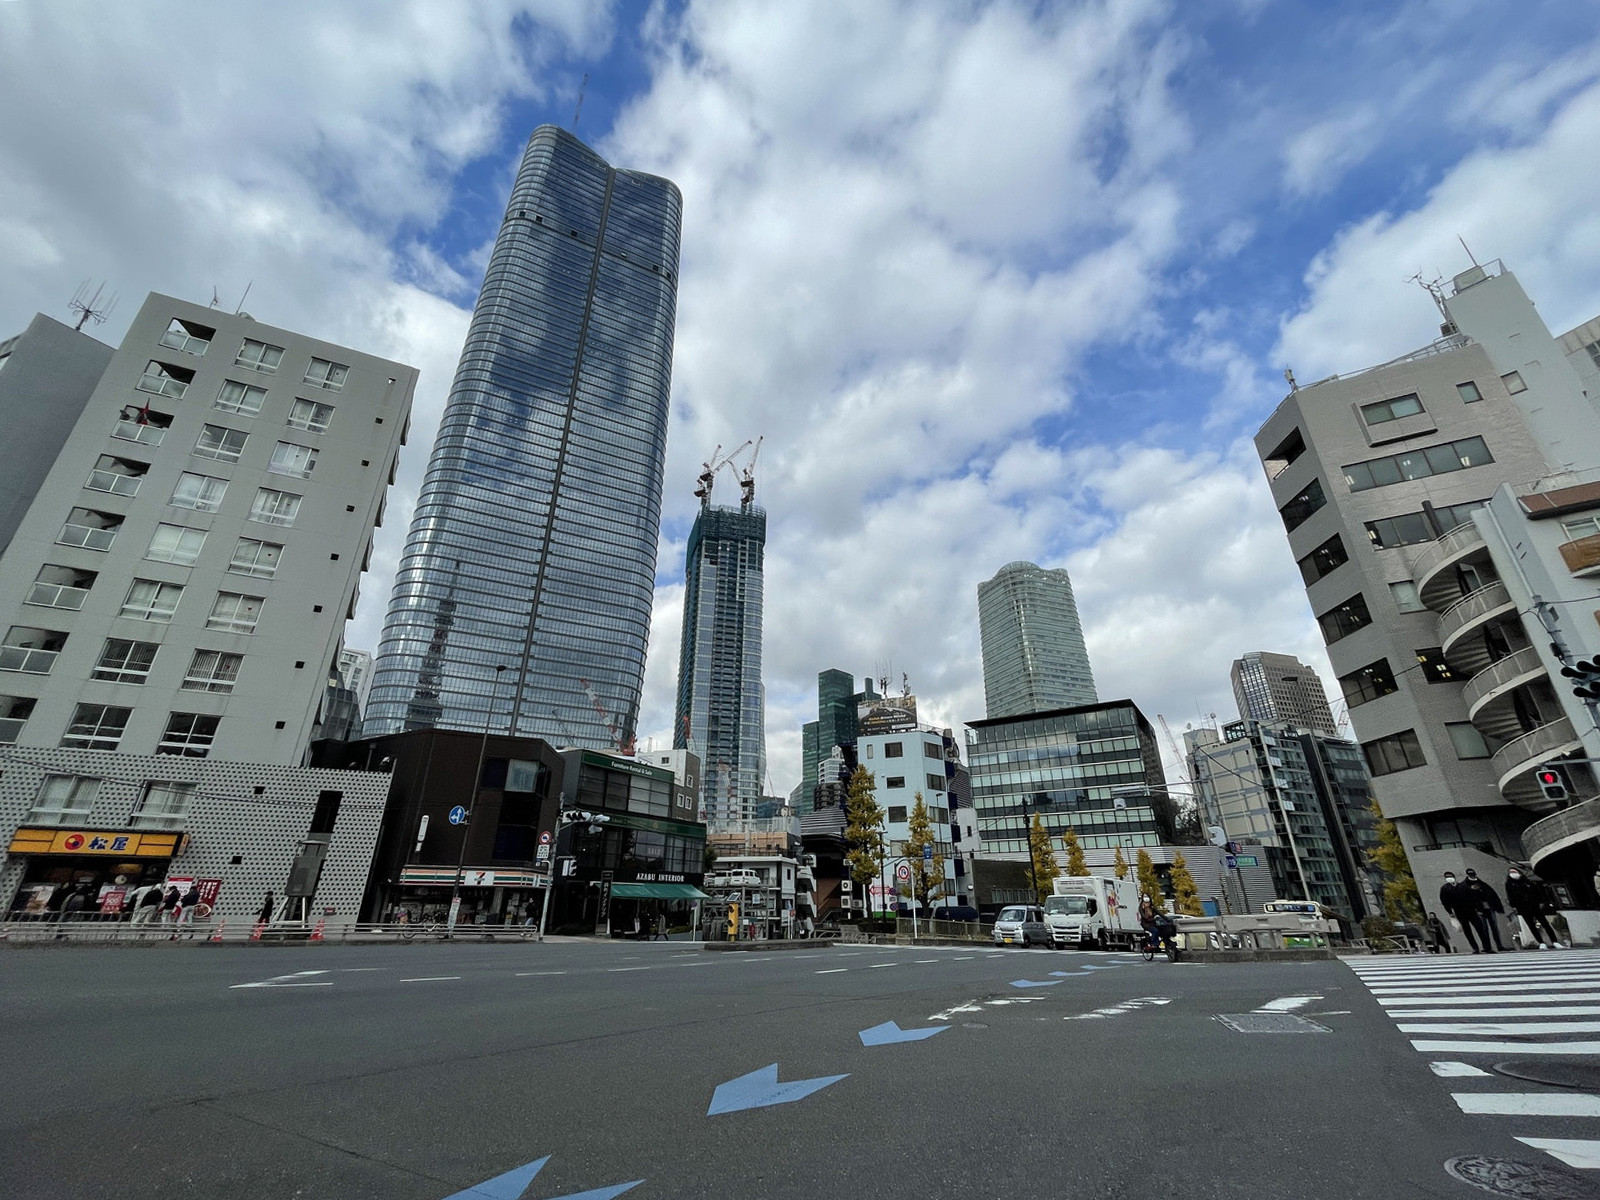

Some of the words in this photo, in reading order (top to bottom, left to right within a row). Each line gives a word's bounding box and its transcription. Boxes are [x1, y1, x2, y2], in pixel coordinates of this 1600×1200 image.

[88, 836, 129, 851] 松屋
[635, 872, 656, 881] AZABU
[658, 873, 685, 882] INTERIOR
